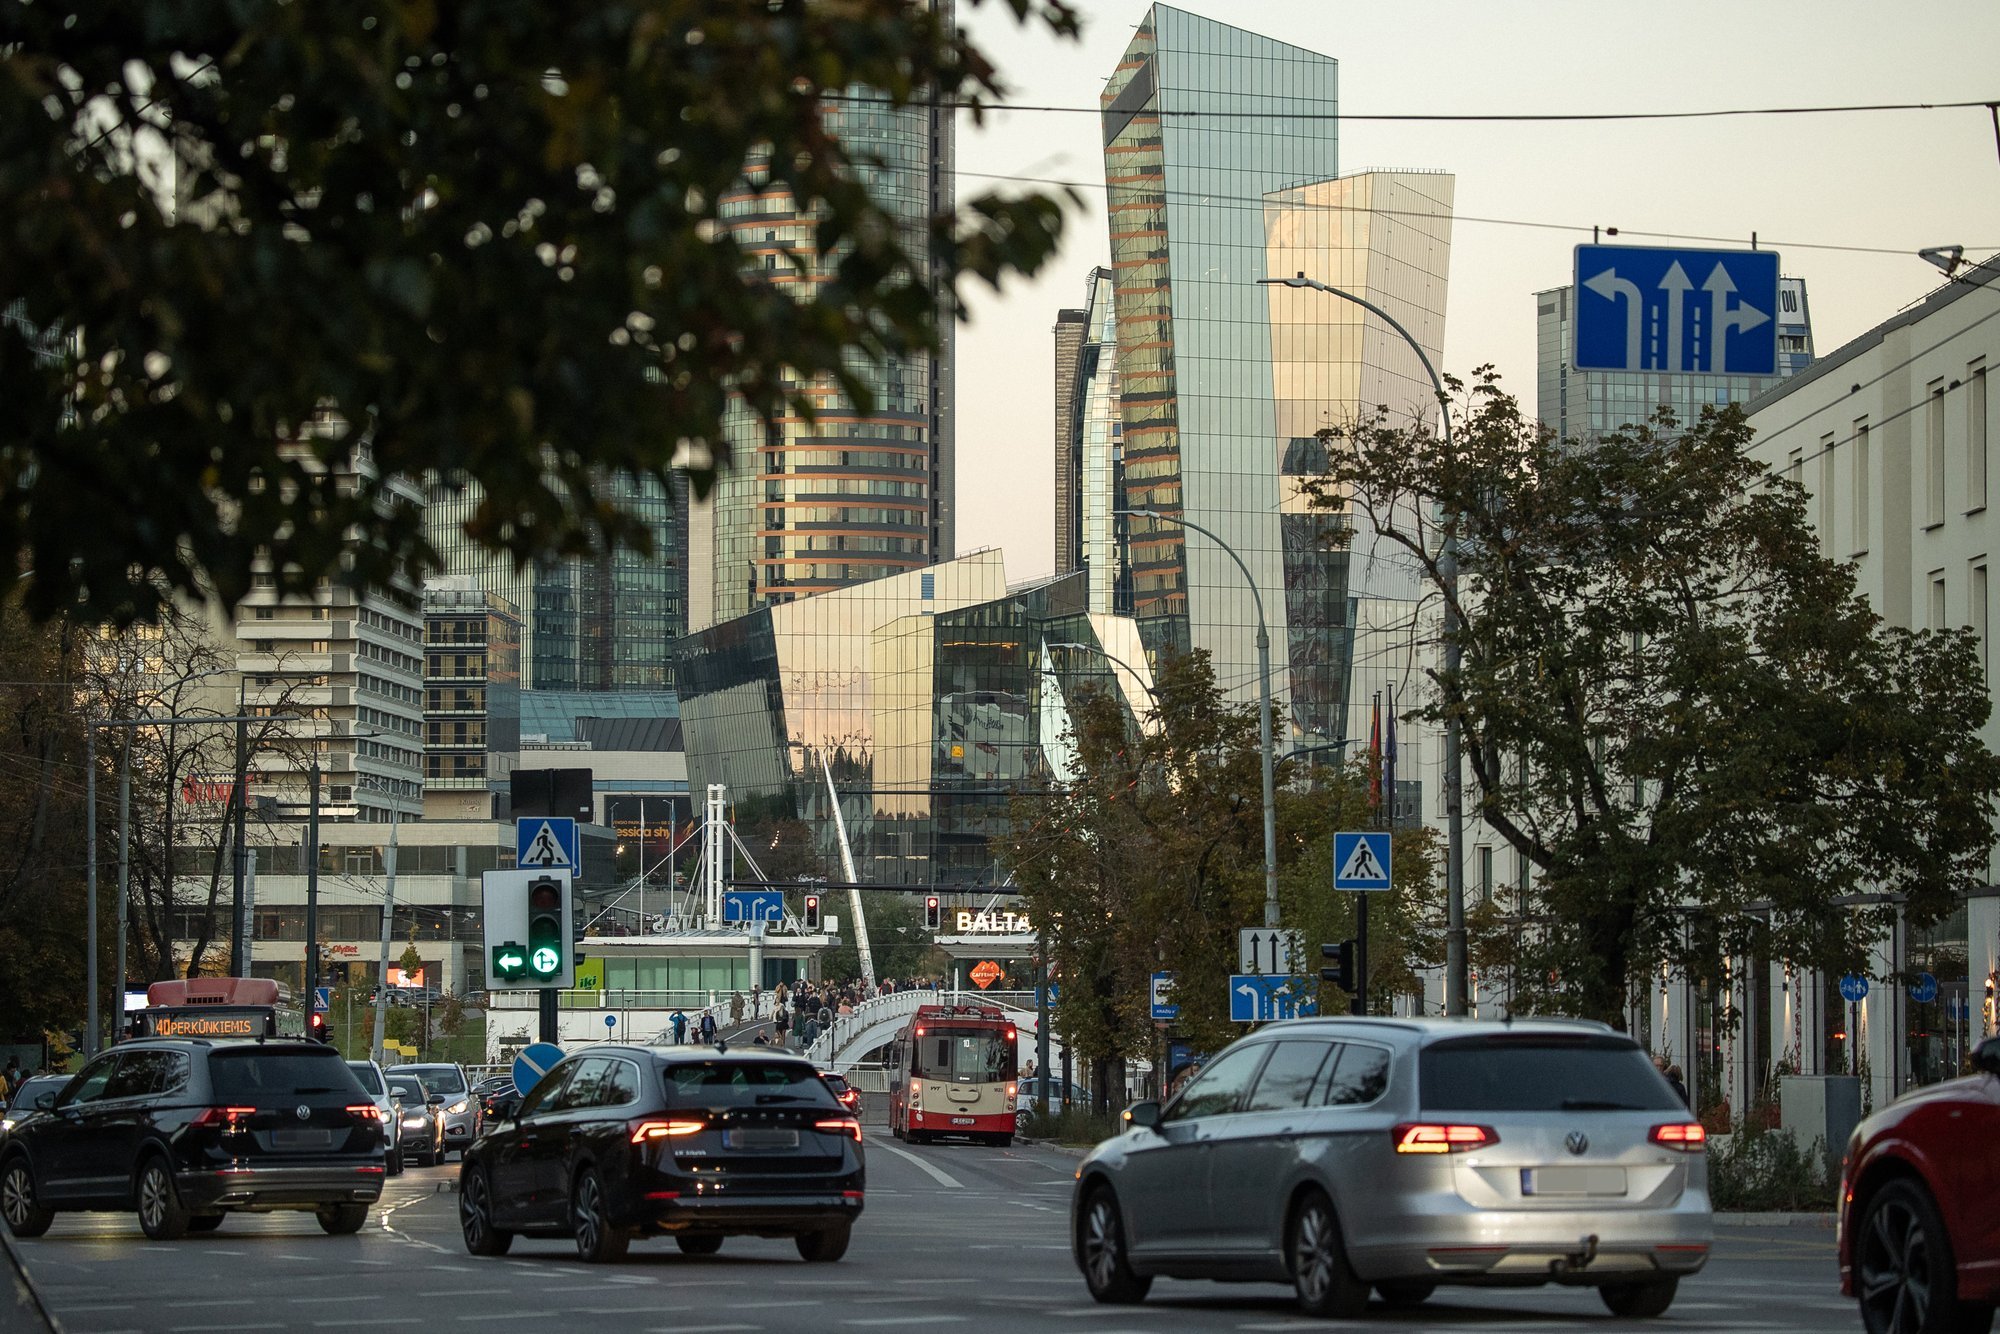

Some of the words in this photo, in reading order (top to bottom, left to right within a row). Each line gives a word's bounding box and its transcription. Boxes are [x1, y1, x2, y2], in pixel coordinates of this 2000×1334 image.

[1779, 290, 1797, 312] OU
[616, 826, 652, 837] essica
[653, 827, 671, 839] shy
[580, 975, 597, 988] iki
[156, 1019, 171, 1035] 40
[171, 1018, 252, 1034] PERKŪNKIEMIS
[963, 1039, 970, 1048] 10
